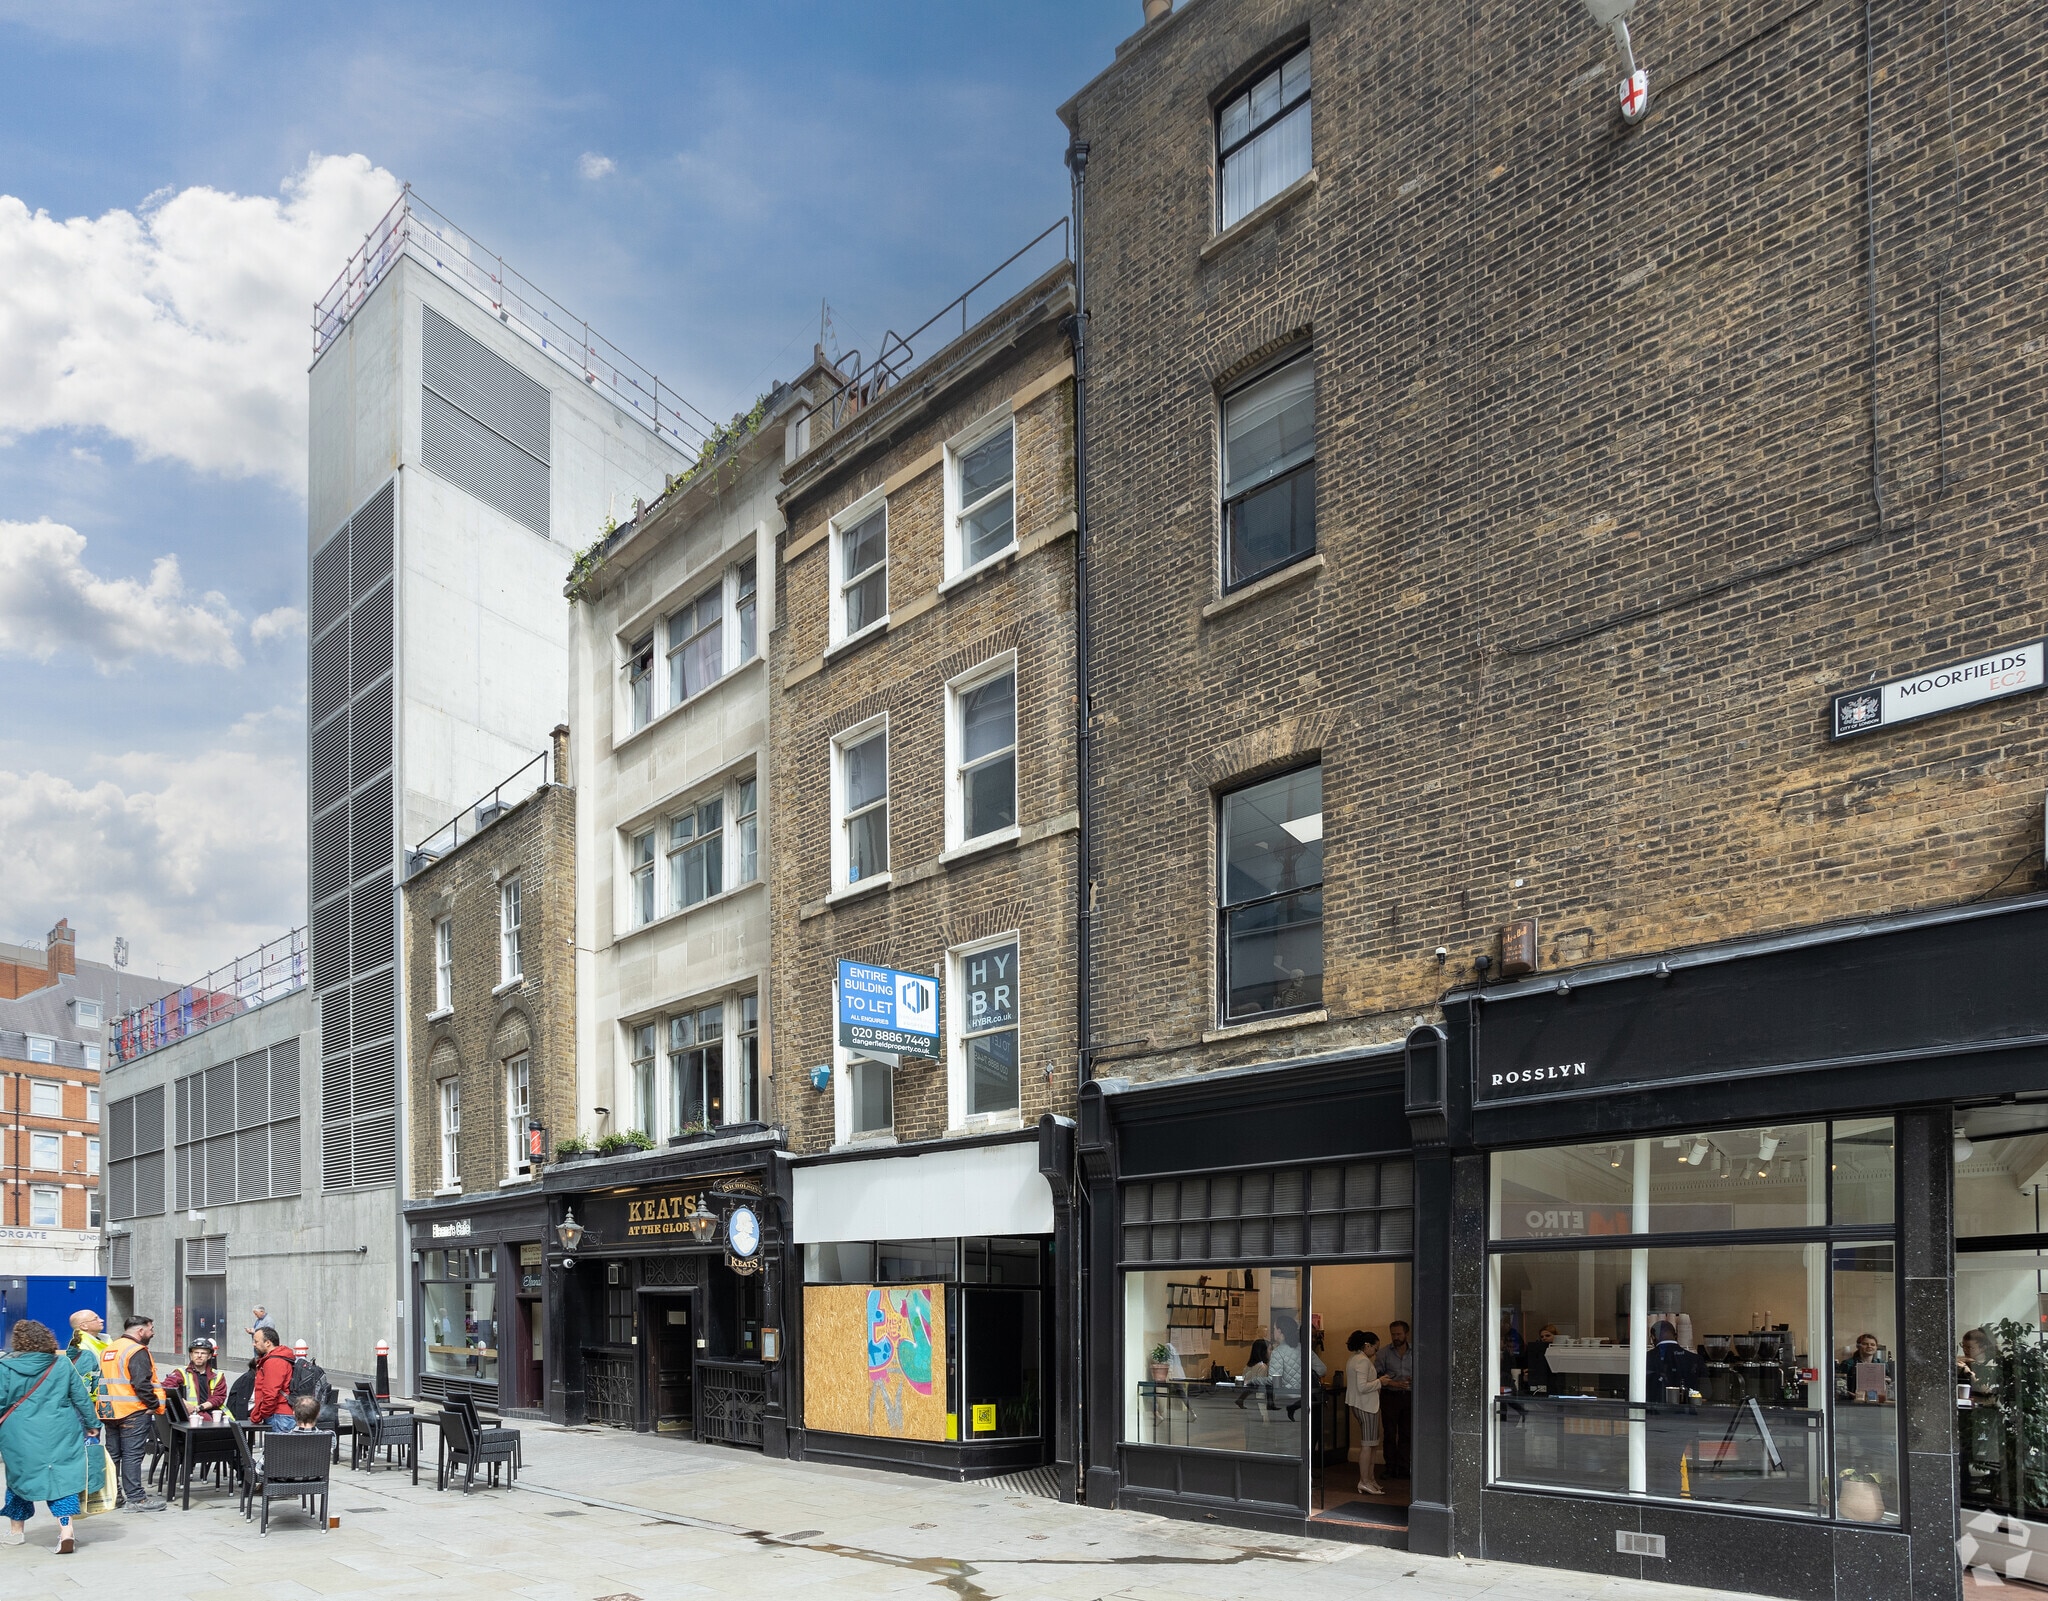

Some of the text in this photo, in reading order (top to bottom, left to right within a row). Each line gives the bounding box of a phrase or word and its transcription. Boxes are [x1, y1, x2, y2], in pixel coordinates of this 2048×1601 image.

[1900, 653, 2026, 699] MOORFIELDS
[1989, 670, 2027, 691] EC2
[1858, 718, 1880, 727] LONDON
[850, 967, 888, 983] ENTIRE
[844, 978, 894, 996] BUILDING
[845, 995, 893, 1015] TO LET
[861, 1015, 890, 1026] ENQUIRIES
[972, 1012, 1012, 1028] HYBR.co.uk
[851, 1026, 931, 1048] 020 8886 7449
[852, 1037, 930, 1055] dangerfieldproperty.co.uk
[1491, 1062, 1586, 1086] ROSSLYN
[628, 1194, 697, 1222] KEATS
[0, 1230, 47, 1240] ORGATE
[628, 1226, 640, 1236] AT
[641, 1224, 661, 1235] THE
[731, 1255, 758, 1268] KEATS
